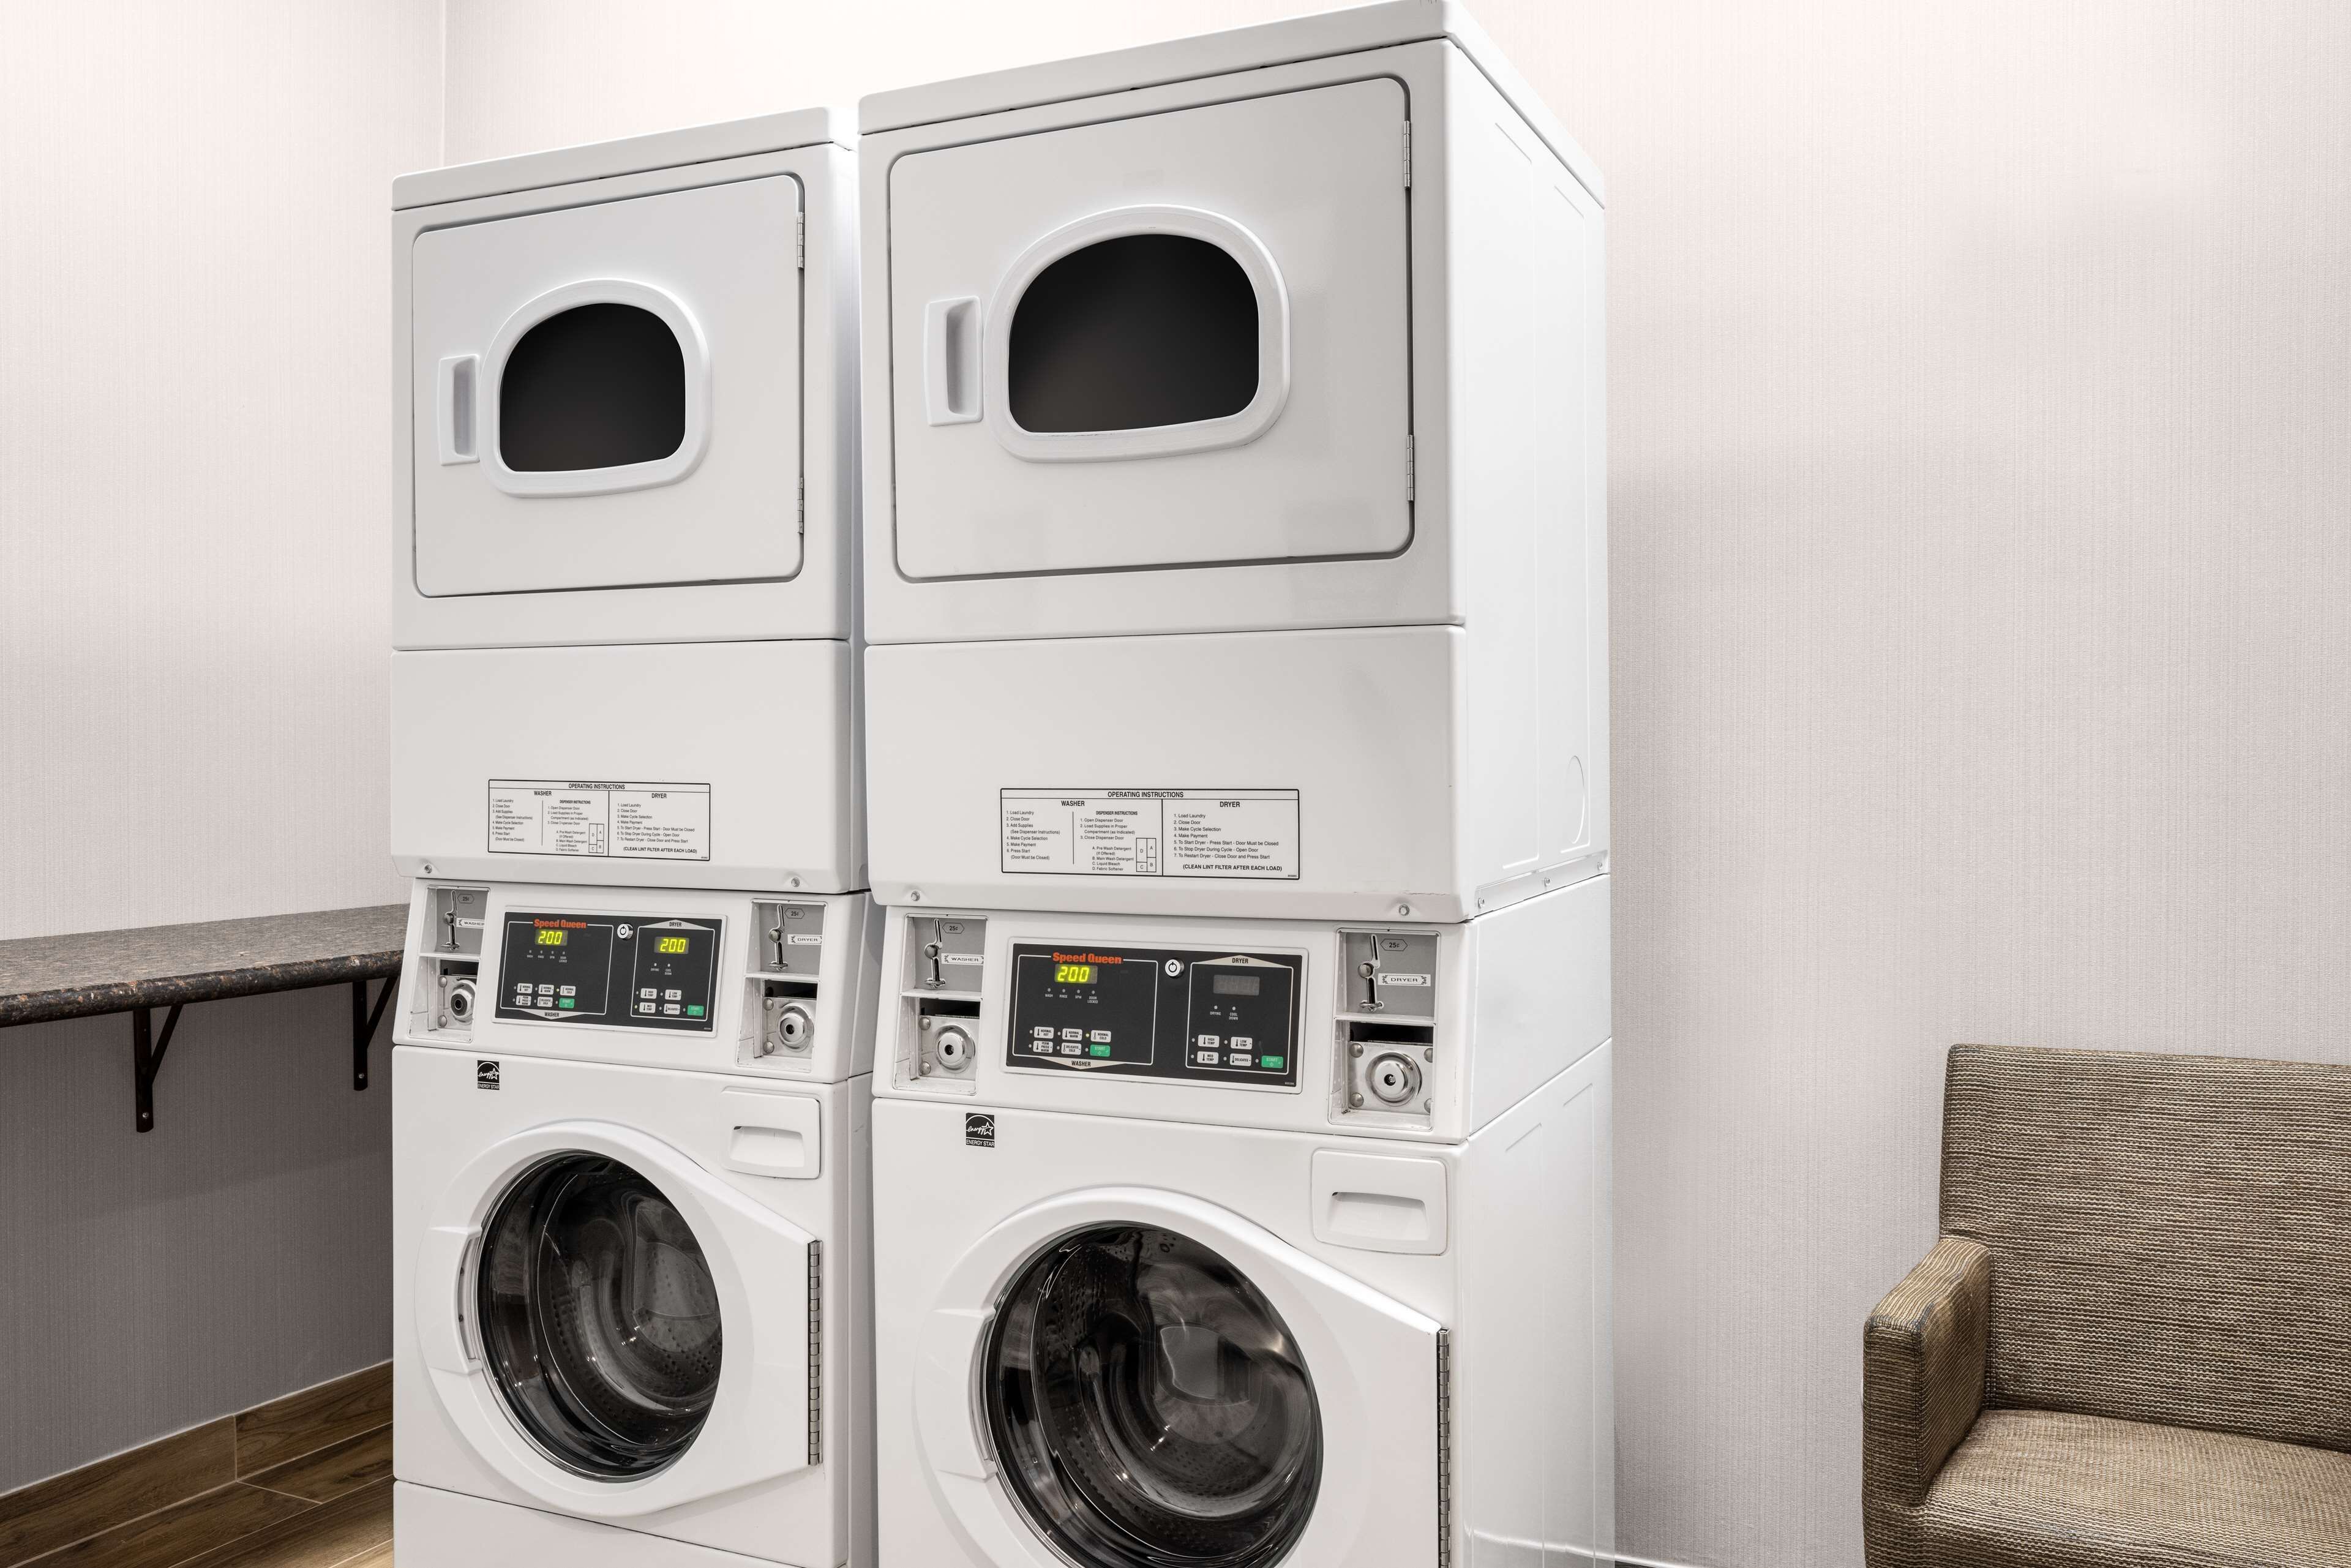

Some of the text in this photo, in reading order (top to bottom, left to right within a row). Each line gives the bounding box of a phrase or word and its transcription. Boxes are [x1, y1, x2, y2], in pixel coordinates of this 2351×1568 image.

[534, 919, 560, 928] Speed
[538, 931, 563, 944] 200
[660, 939, 686, 952] 200
[1053, 953, 1122, 964] Speed Queen
[1058, 967, 1089, 982] 200
